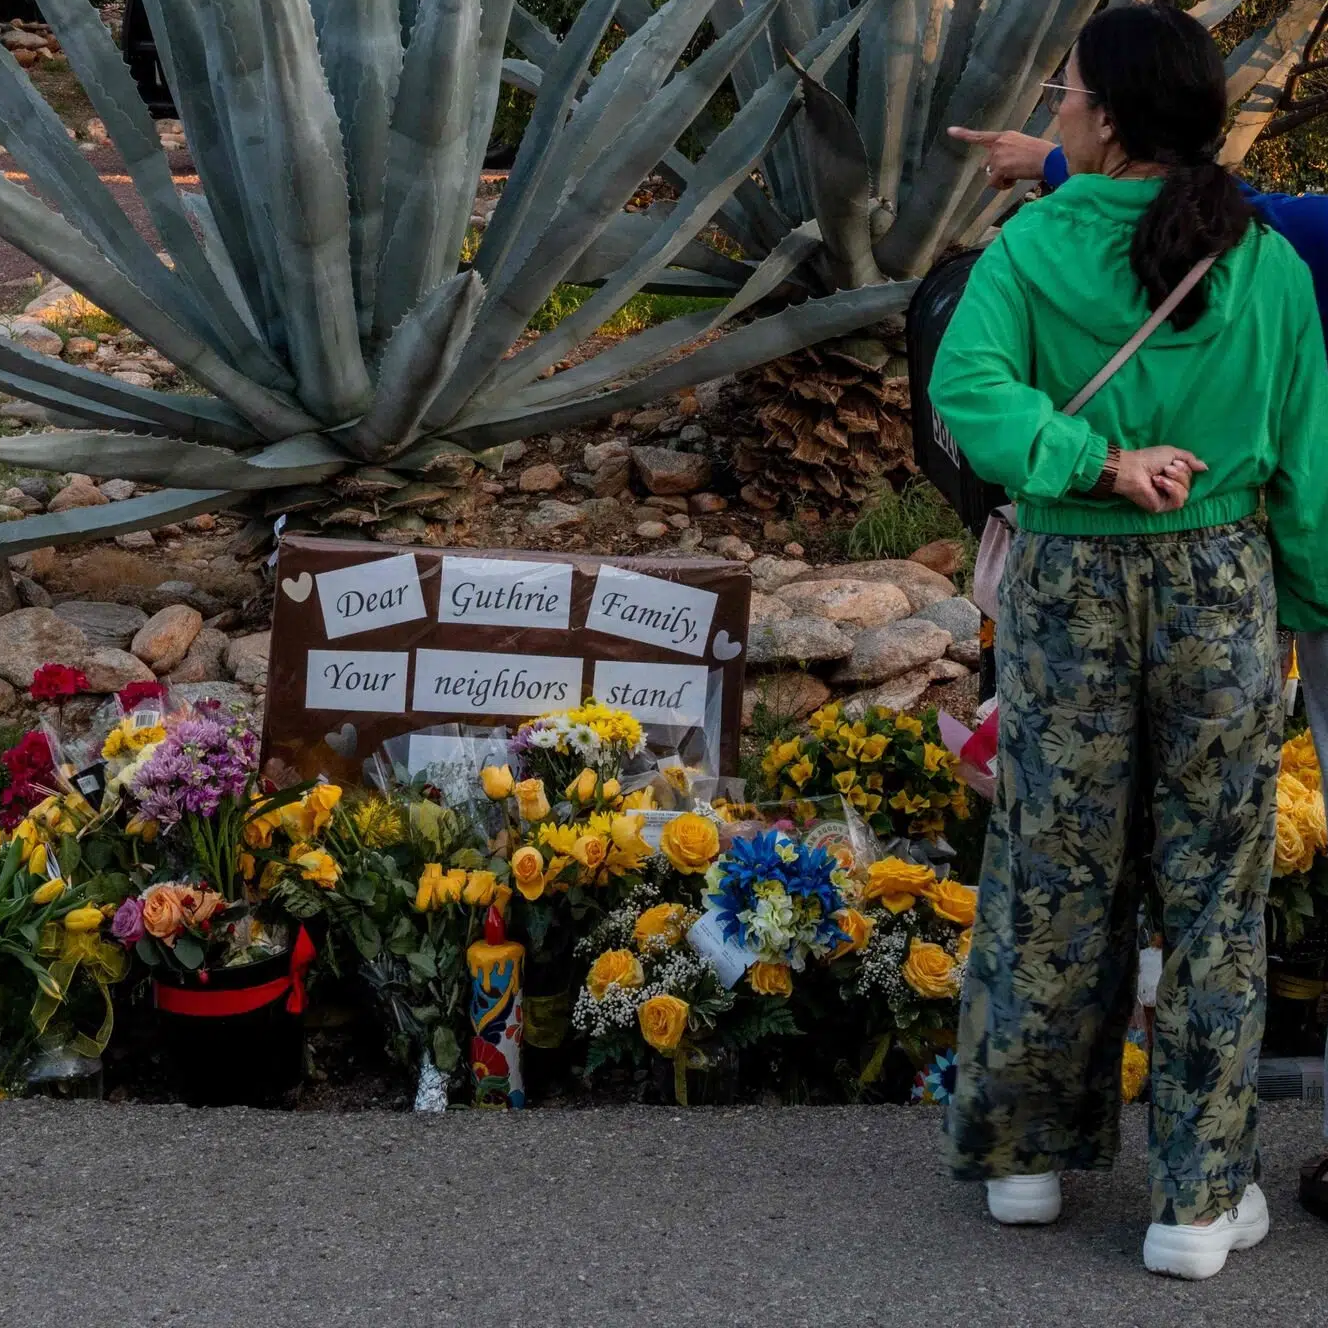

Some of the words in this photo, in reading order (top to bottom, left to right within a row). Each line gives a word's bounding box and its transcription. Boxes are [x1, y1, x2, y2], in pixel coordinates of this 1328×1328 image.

[336, 584, 409, 618] Dear
[451, 581, 559, 617] Guthrie
[601, 592, 698, 644] Family,
[323, 661, 397, 692] Your
[434, 668, 568, 707] neighbors
[605, 680, 692, 709] stand
